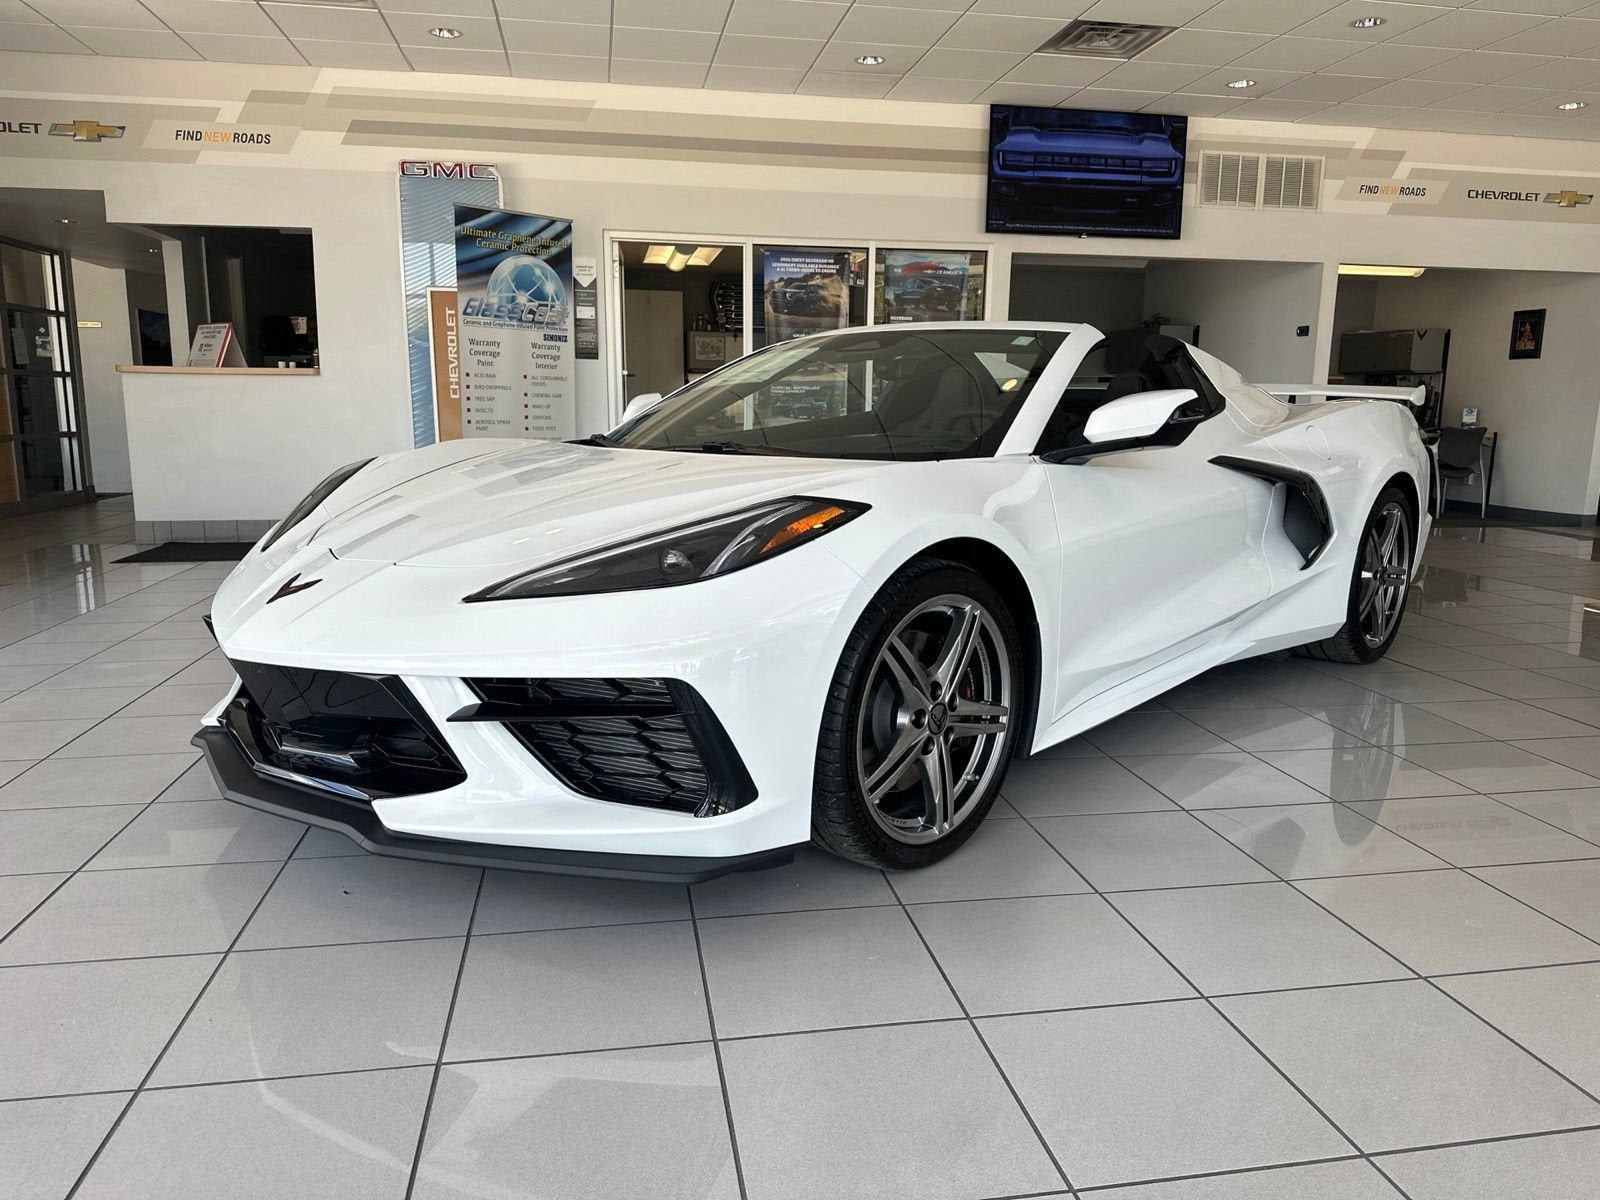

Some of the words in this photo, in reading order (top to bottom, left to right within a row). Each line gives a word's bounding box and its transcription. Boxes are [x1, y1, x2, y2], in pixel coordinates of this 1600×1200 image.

[175, 130, 203, 141] FIND
[204, 131, 231, 142] NEW
[233, 132, 271, 144] ROADS
[400, 160, 498, 180] GMC
[1359, 184, 1380, 195] FIND
[1380, 185, 1399, 195] NEW
[1399, 186, 1427, 197] ROADS
[1467, 189, 1541, 202] CHEVROLET
[460, 225, 497, 240] Ultimate
[498, 231, 536, 245] Graphene
[476, 238, 510, 251] Ceramic
[512, 243, 553, 256] Protection
[463, 318, 482, 327] Ceramic
[468, 337, 501, 349] Warranty
[531, 342, 561, 352] Warranty
[445, 306, 461, 399] CHEVROLET
[469, 347, 501, 359] Coverage
[531, 351, 561, 362] Coverage
[477, 359, 494, 367] Paint
[535, 361, 558, 370] Interior
